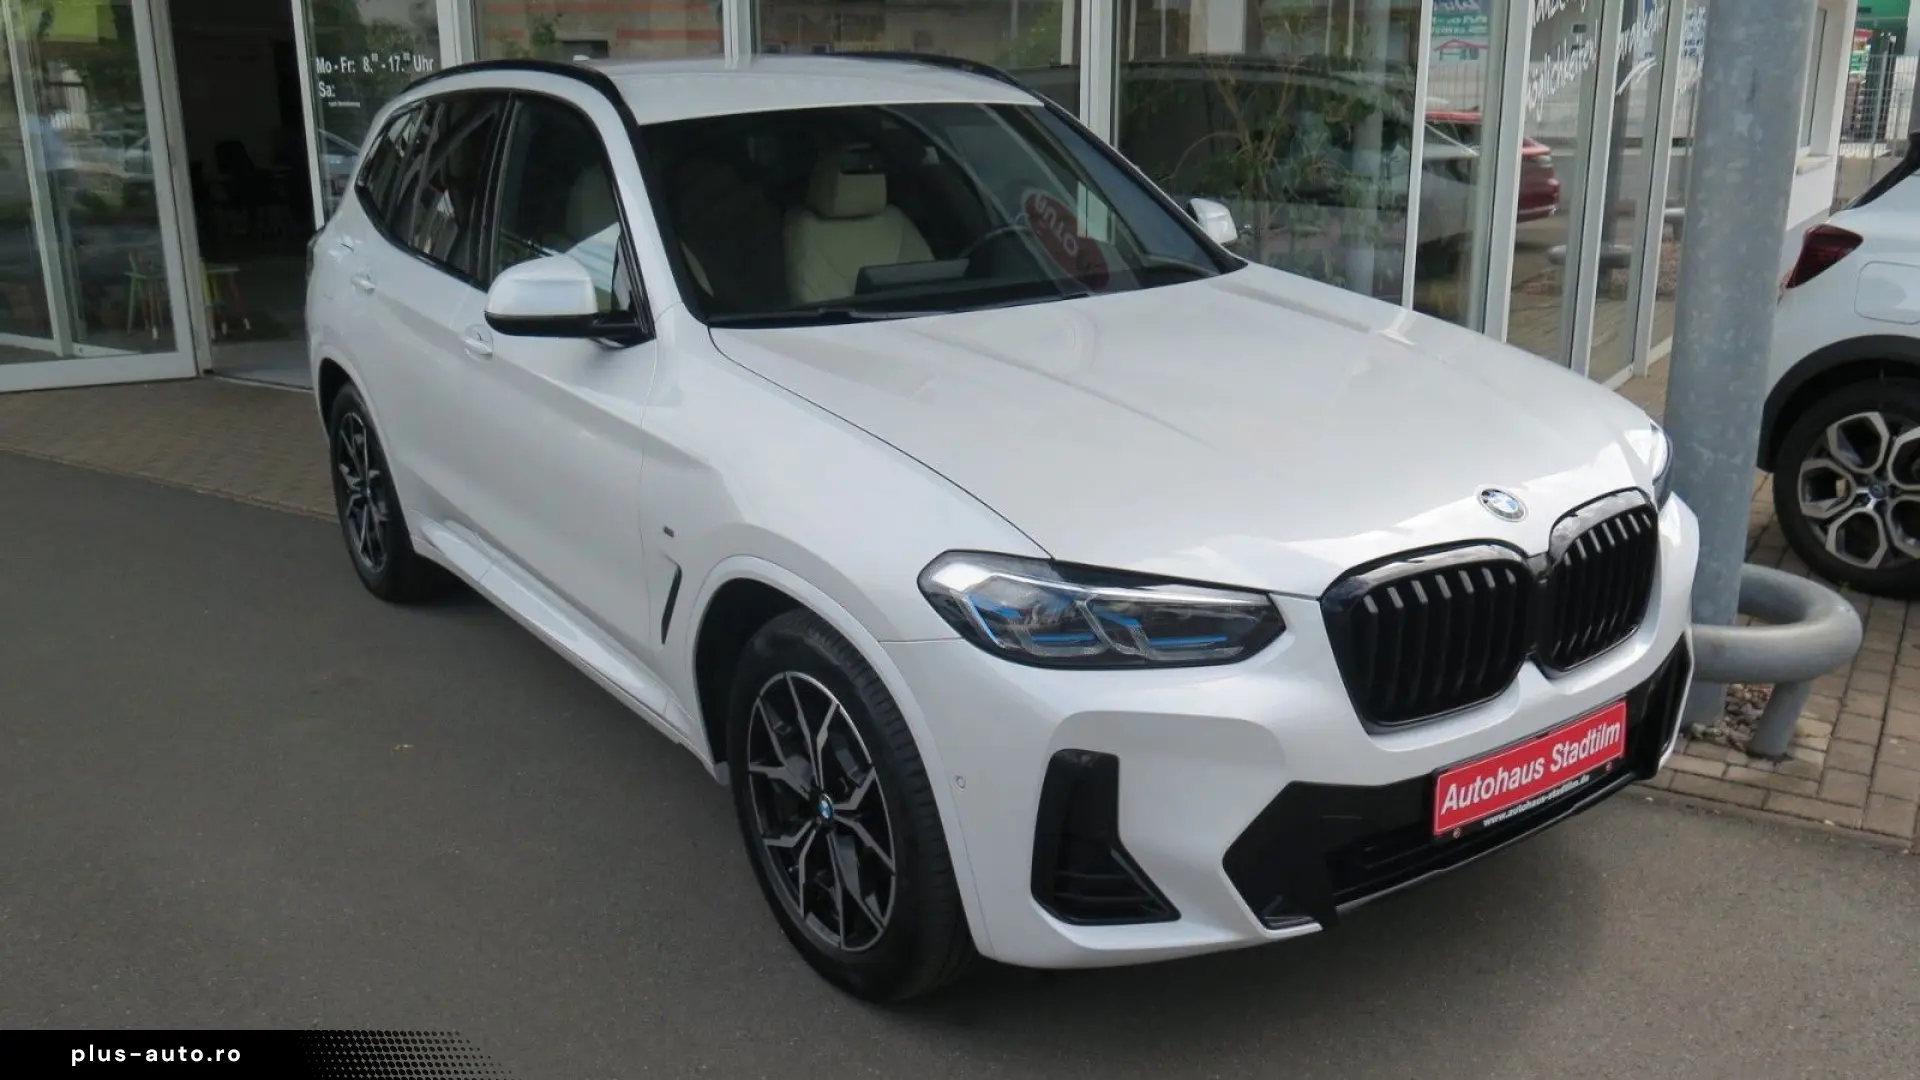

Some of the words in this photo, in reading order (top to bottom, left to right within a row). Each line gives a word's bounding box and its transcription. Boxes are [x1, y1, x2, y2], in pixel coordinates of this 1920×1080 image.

[316, 56, 332, 74] Mo
[413, 54, 434, 73] Uhr
[1440, 756, 1546, 815] Autohaus
[1550, 721, 1621, 774] Stadtilm
